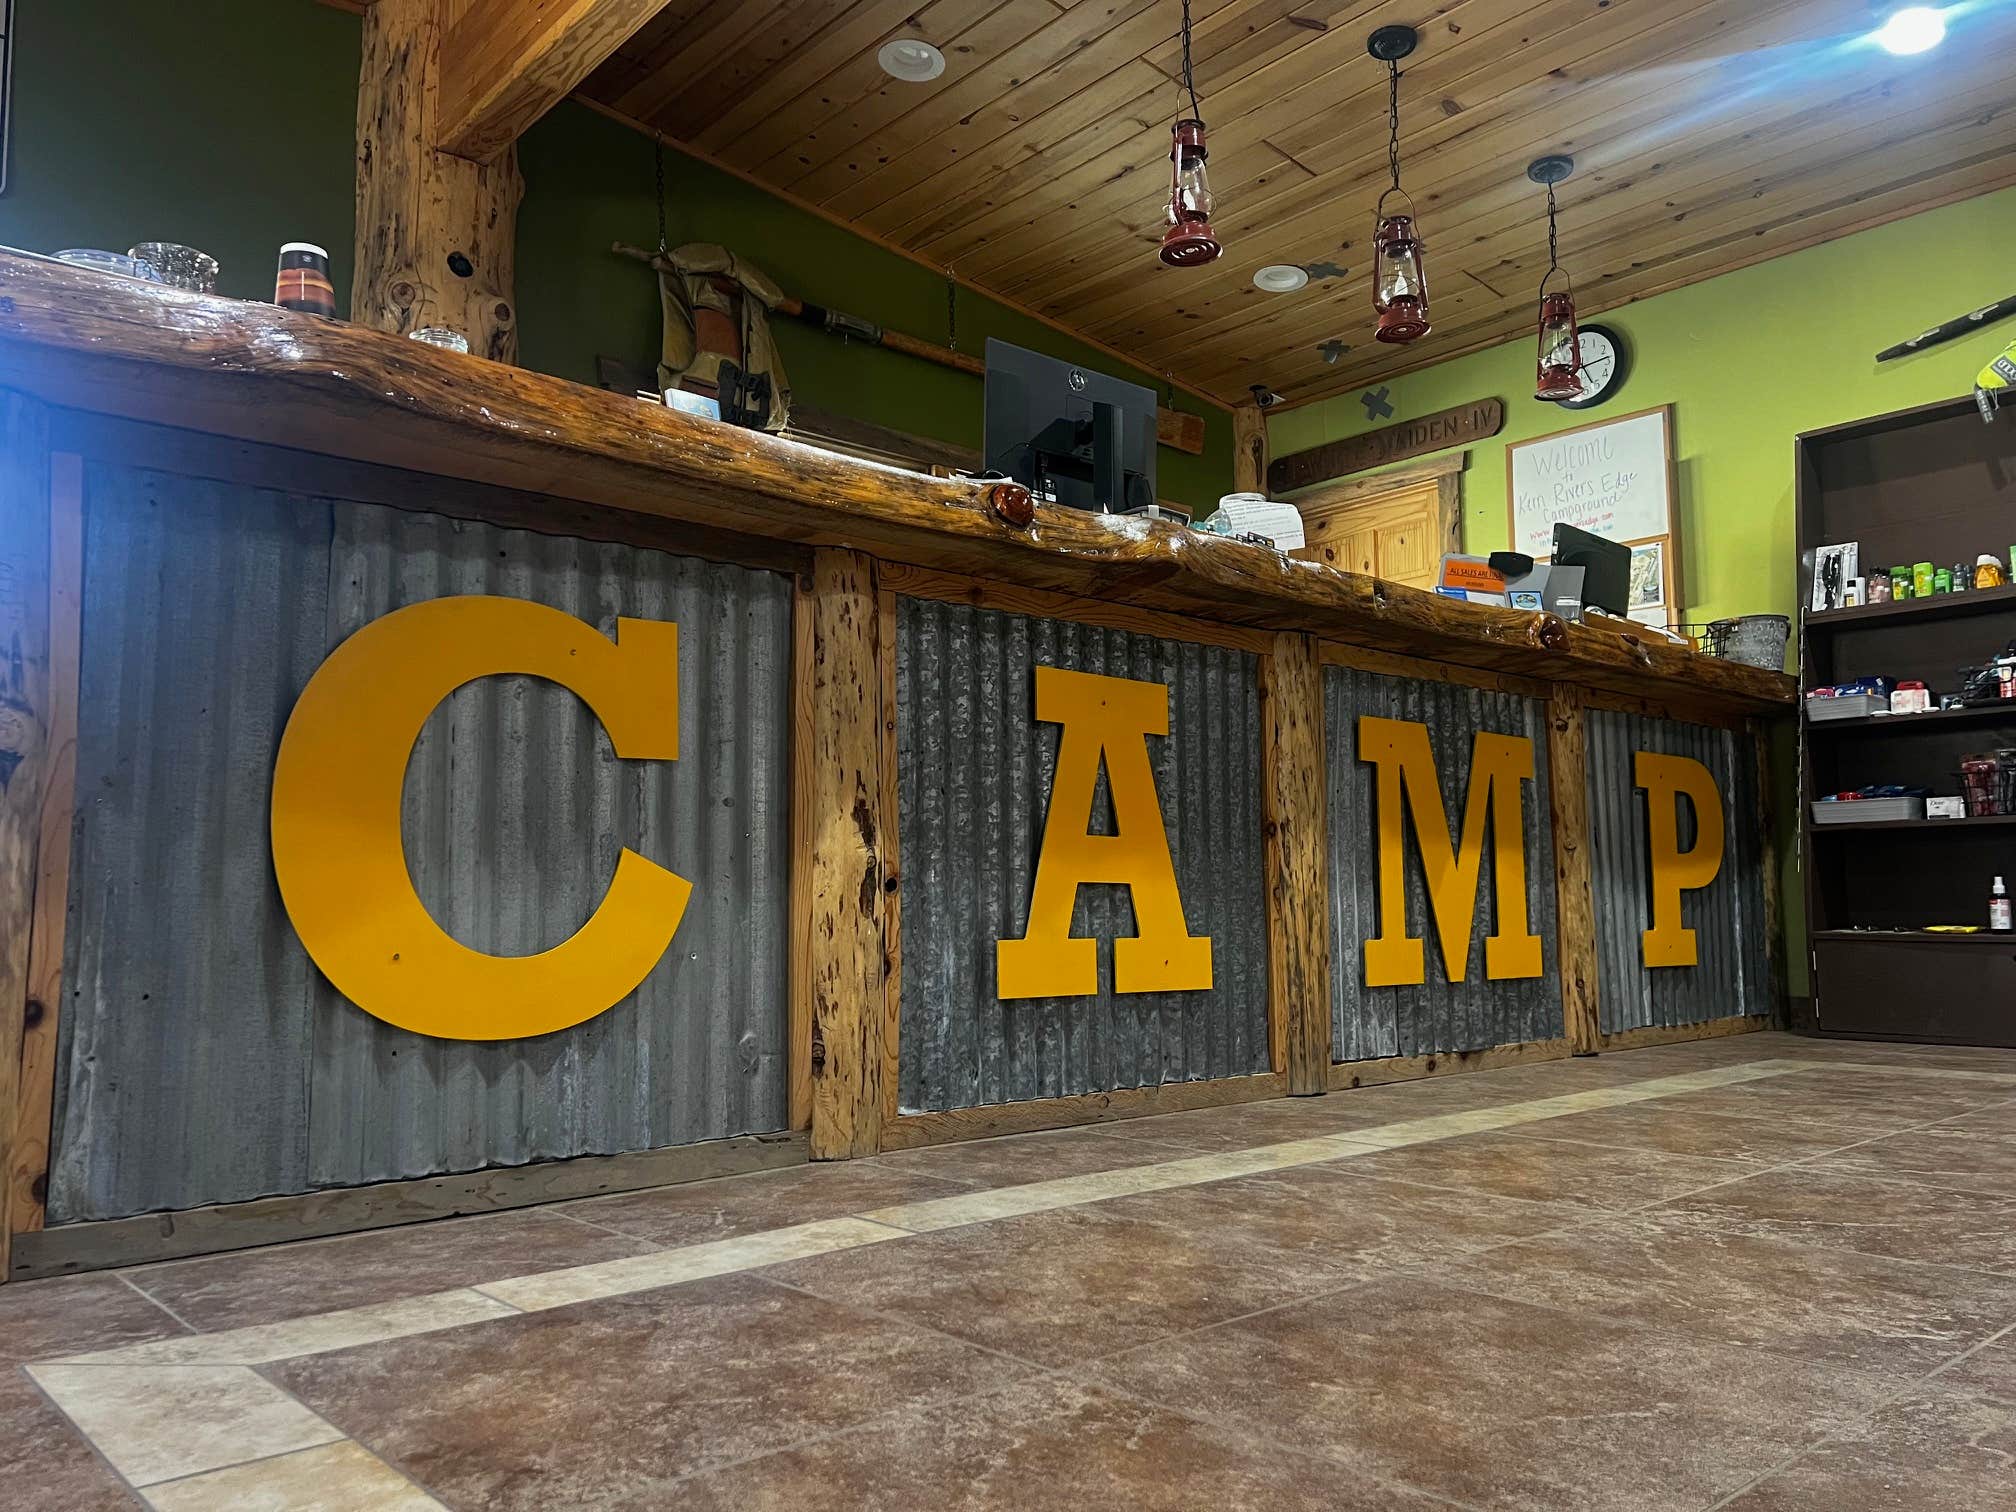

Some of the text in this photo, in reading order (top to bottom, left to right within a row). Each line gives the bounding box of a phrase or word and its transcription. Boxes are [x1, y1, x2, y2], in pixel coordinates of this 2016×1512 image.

[1532, 436, 1614, 476] Welcome
[1554, 479, 1594, 505] Rivers
[1600, 472, 1638, 494] Edge
[1543, 492, 1622, 524] Campground
